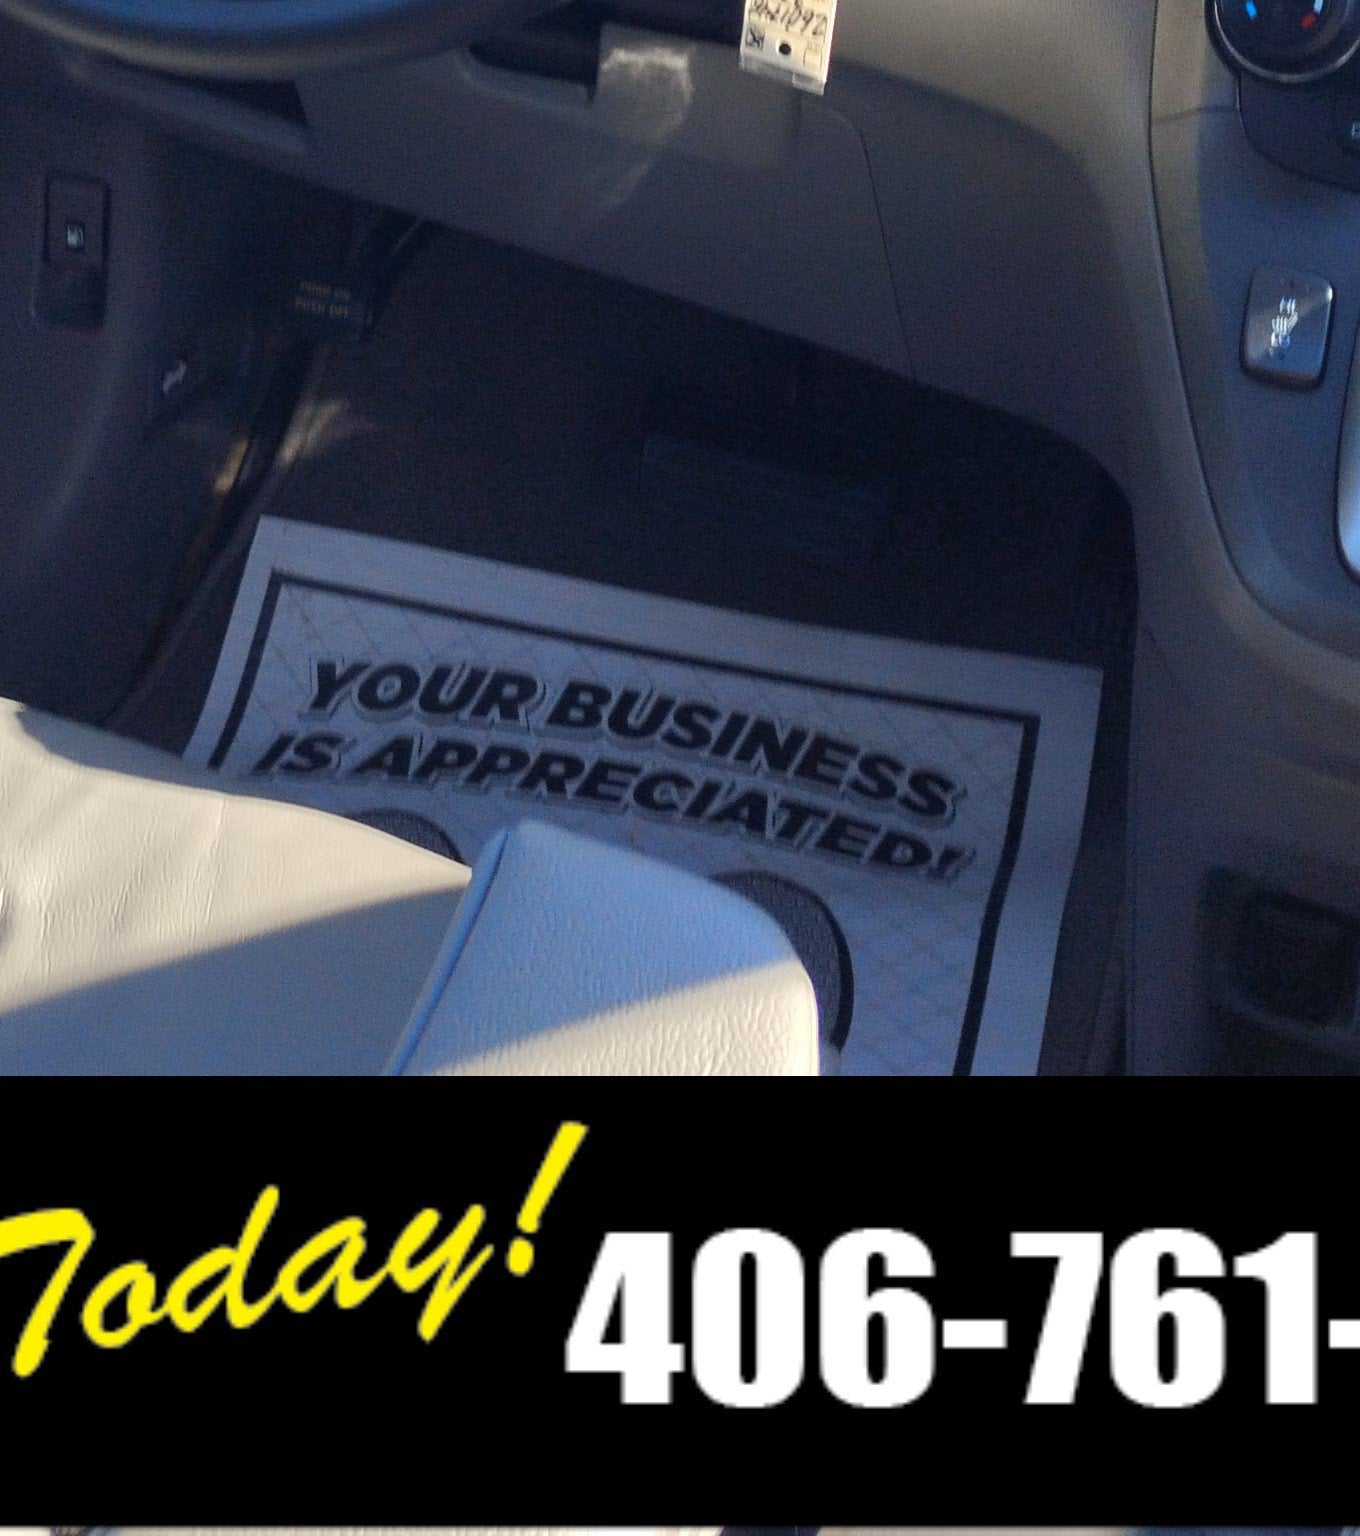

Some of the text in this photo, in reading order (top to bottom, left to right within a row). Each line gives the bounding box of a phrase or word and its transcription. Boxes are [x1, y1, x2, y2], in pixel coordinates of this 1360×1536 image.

[250, 731, 974, 880] IS APPRECIATED!
[306, 658, 962, 822] YOUR BUSINESS
